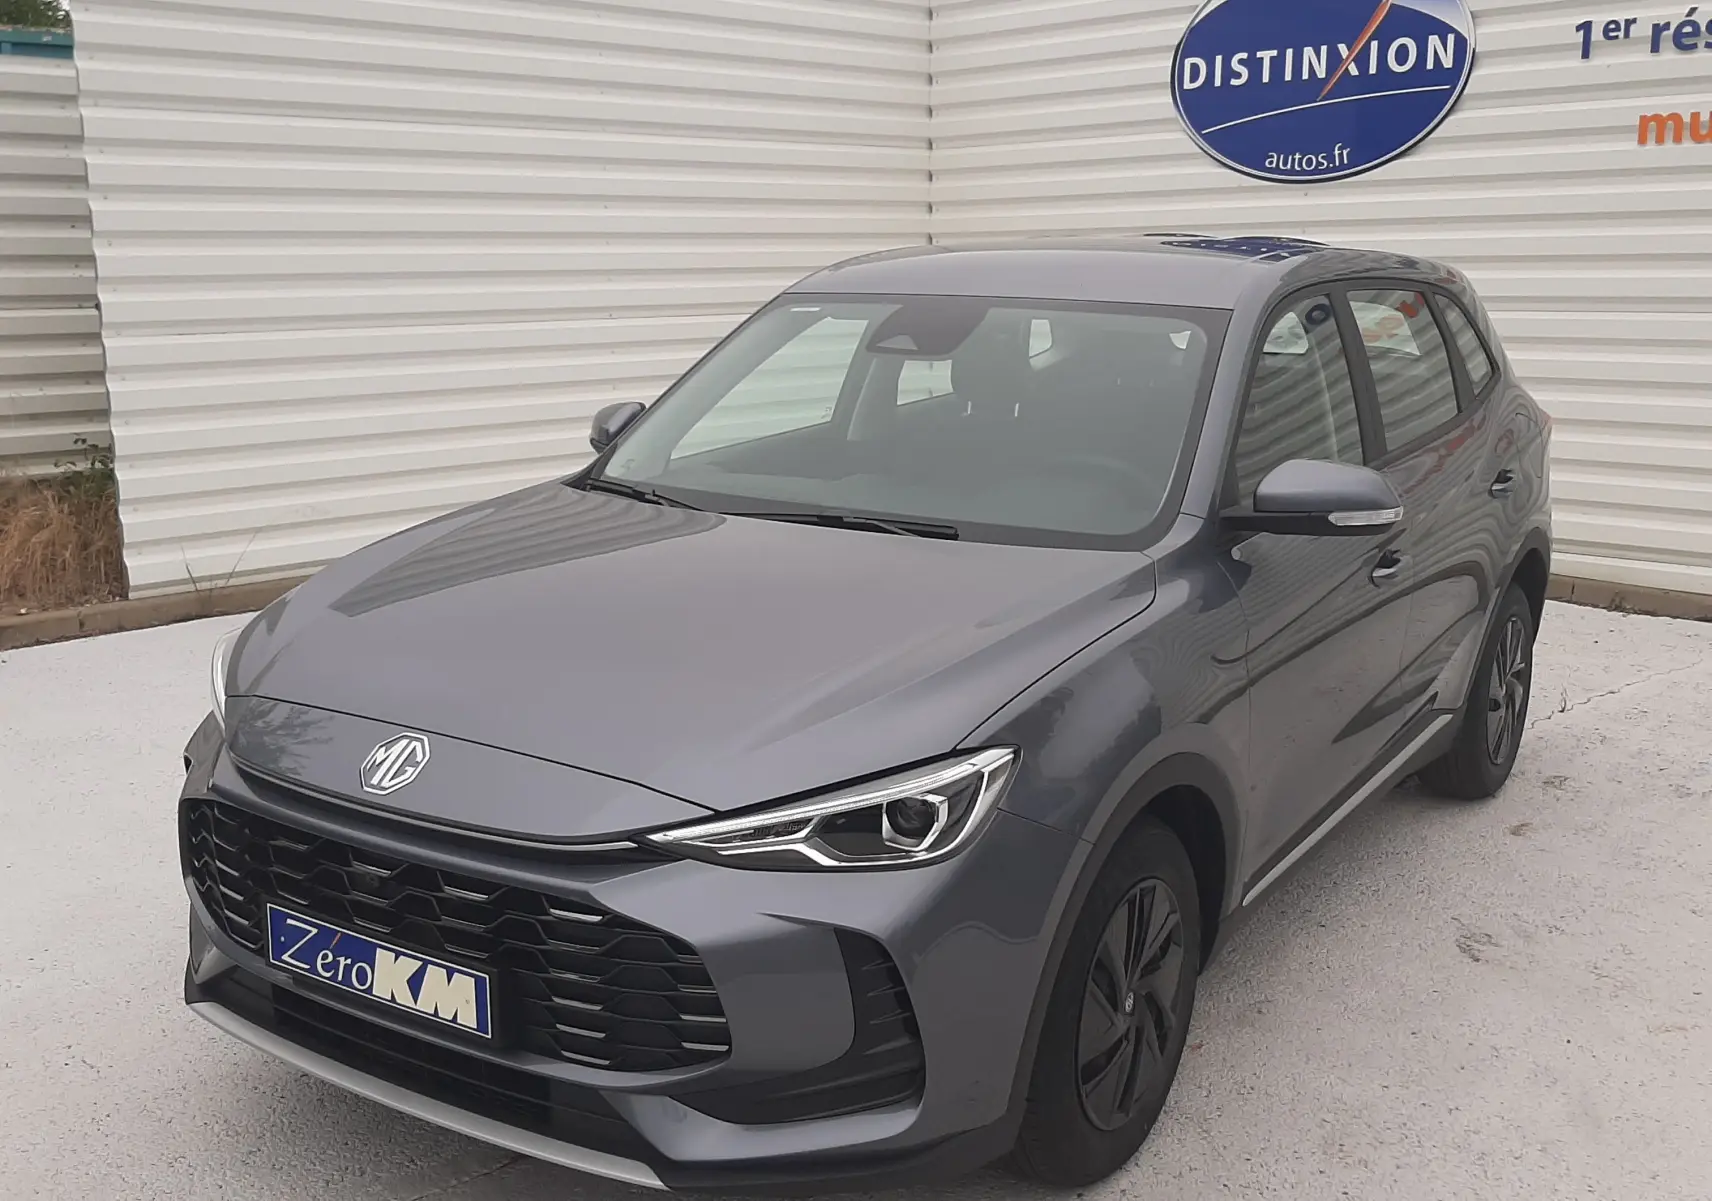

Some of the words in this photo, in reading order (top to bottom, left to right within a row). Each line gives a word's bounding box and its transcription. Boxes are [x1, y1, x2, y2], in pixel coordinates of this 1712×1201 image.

[1575, 17, 1638, 60] 1er
[1182, 32, 1456, 101] DISTINXION
[1265, 142, 1351, 171] autos.fr
[366, 738, 424, 789] MG
